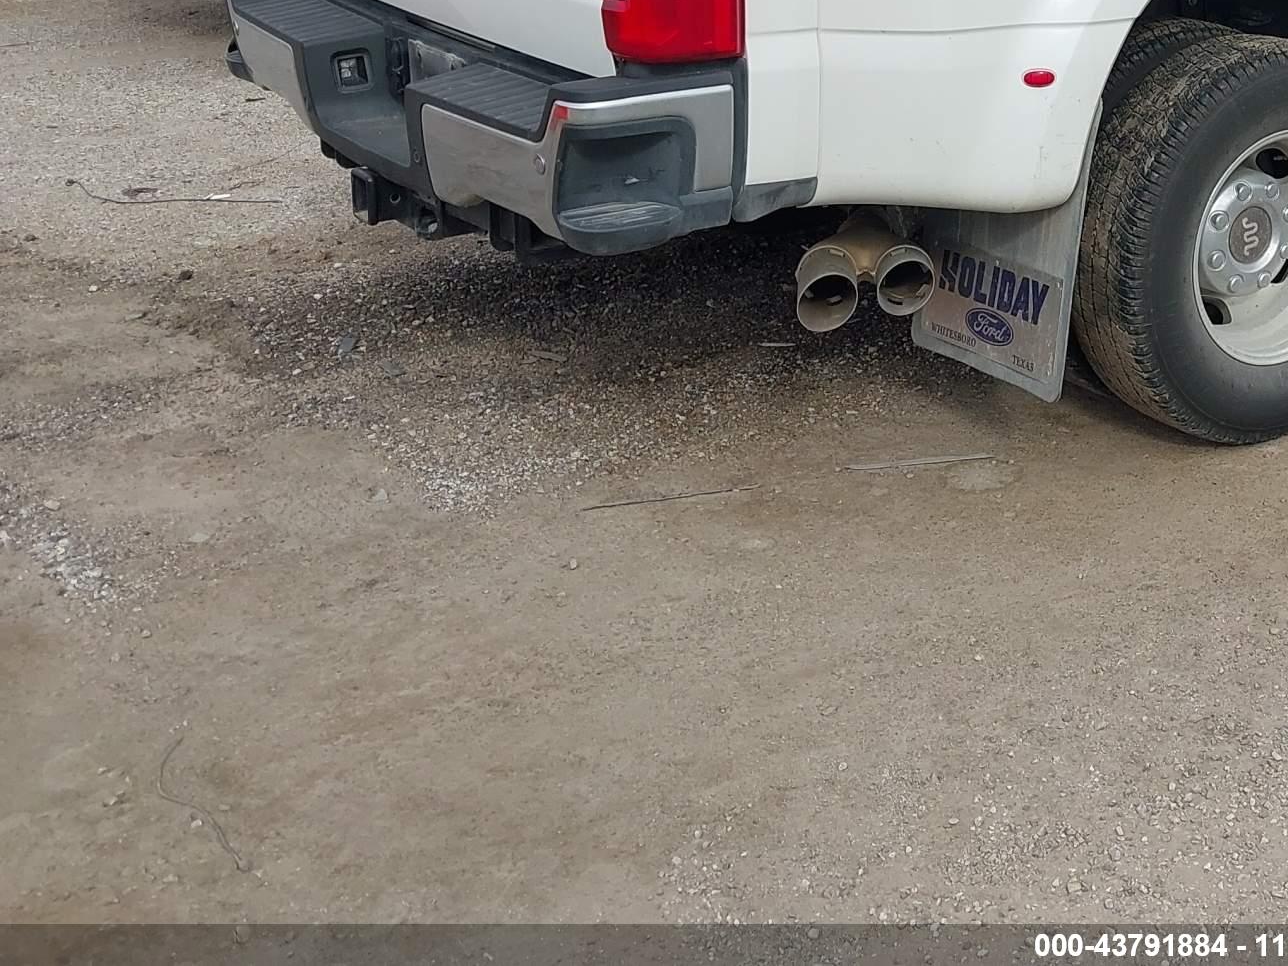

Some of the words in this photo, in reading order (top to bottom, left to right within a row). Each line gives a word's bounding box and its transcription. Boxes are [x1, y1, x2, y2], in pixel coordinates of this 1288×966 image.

[938, 249, 1050, 325] HOLIDAY
[931, 321, 976, 347] WHITESBORO
[970, 311, 1009, 344] Ford
[1011, 354, 1036, 372] TEXAS
